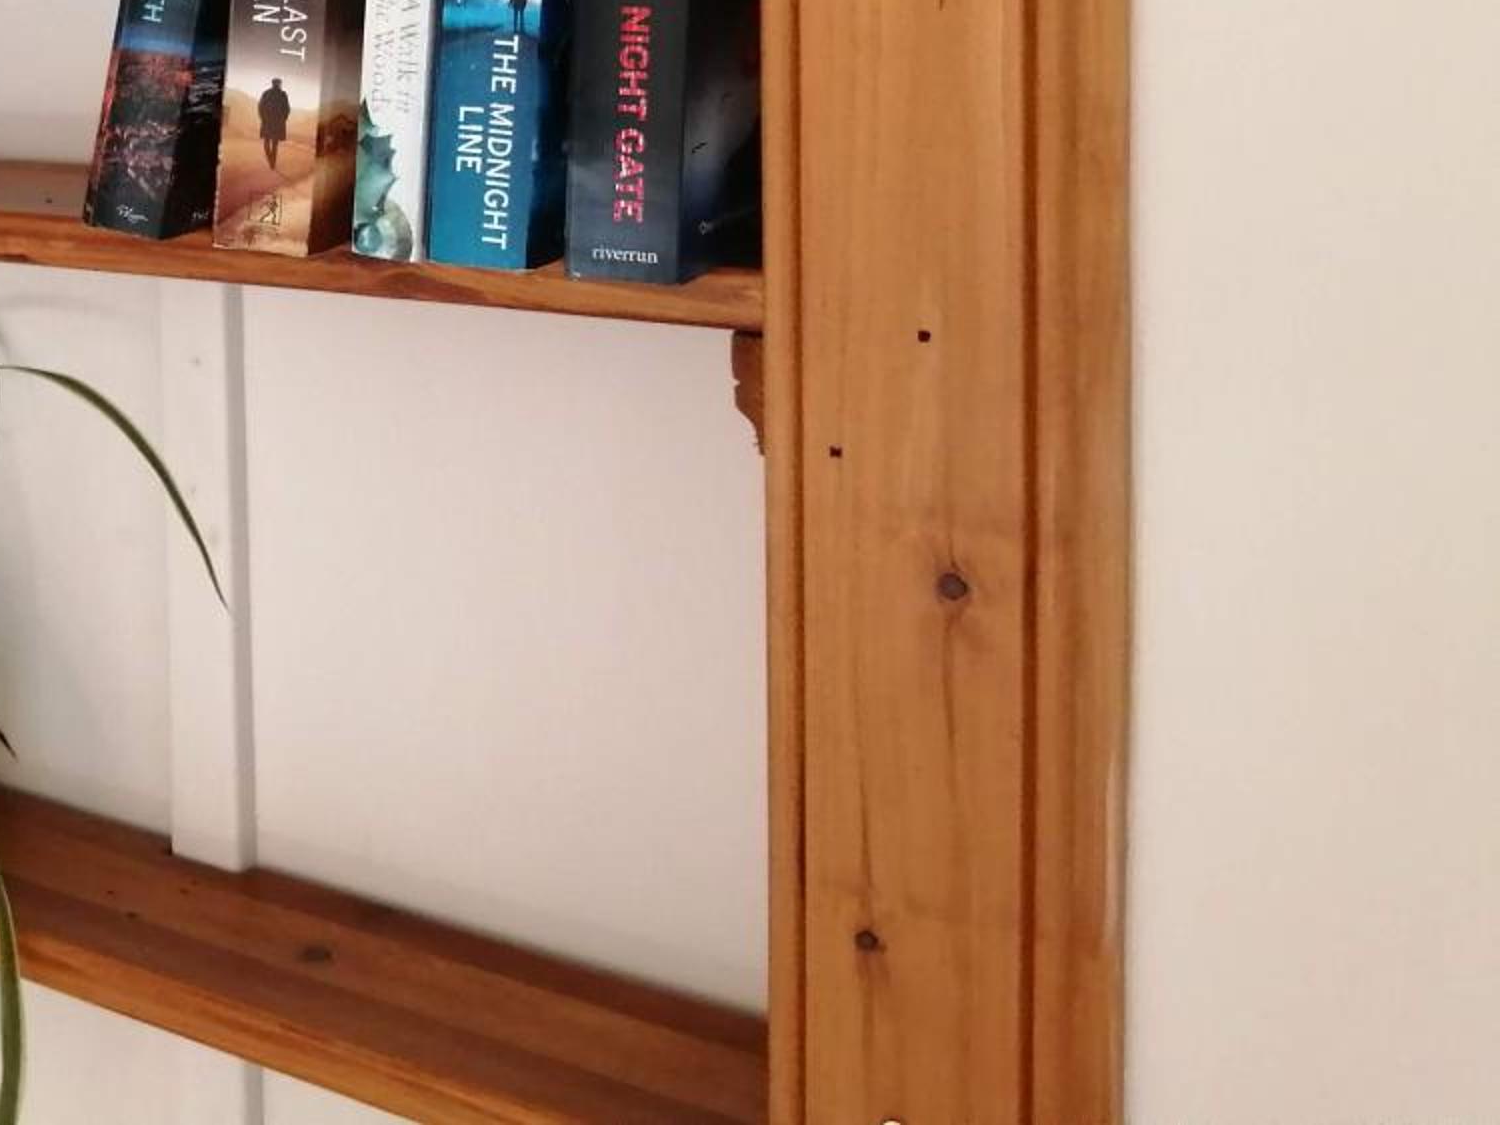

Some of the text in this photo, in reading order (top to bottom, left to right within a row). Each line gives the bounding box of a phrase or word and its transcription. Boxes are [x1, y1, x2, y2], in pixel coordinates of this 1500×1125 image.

[617, 6, 651, 121] NIGHT
[455, 106, 485, 174] LINE
[481, 34, 519, 250] THE MIDNIGHT
[612, 127, 645, 223] GATE
[592, 245, 659, 265] riverrun
